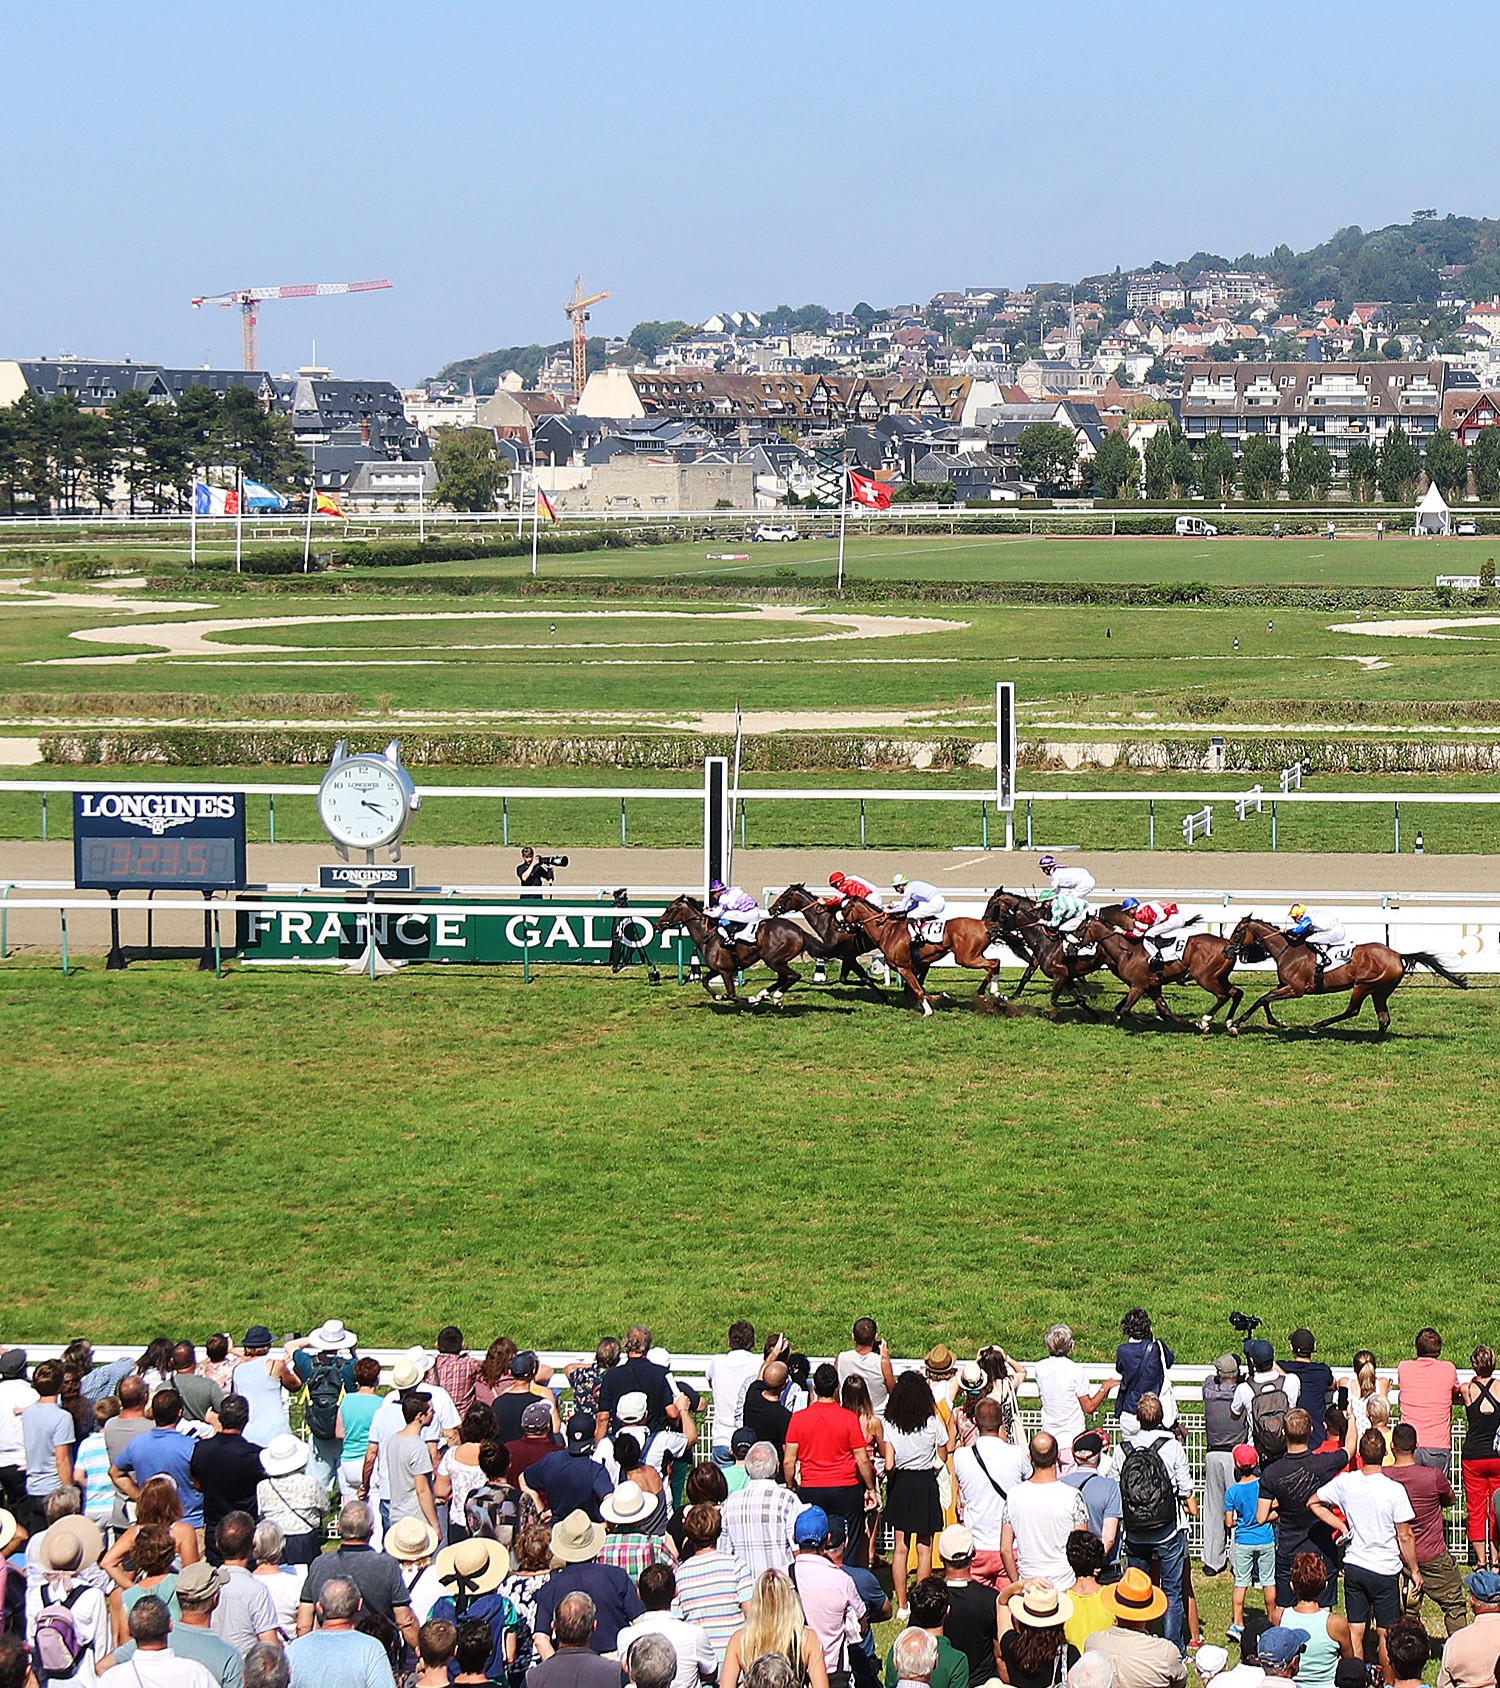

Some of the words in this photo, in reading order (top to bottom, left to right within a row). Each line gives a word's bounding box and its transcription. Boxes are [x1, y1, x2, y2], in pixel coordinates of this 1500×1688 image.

[82, 794, 236, 818] LONGINES
[332, 870, 398, 880] LONGINES
[248, 911, 467, 947] FRANCE
